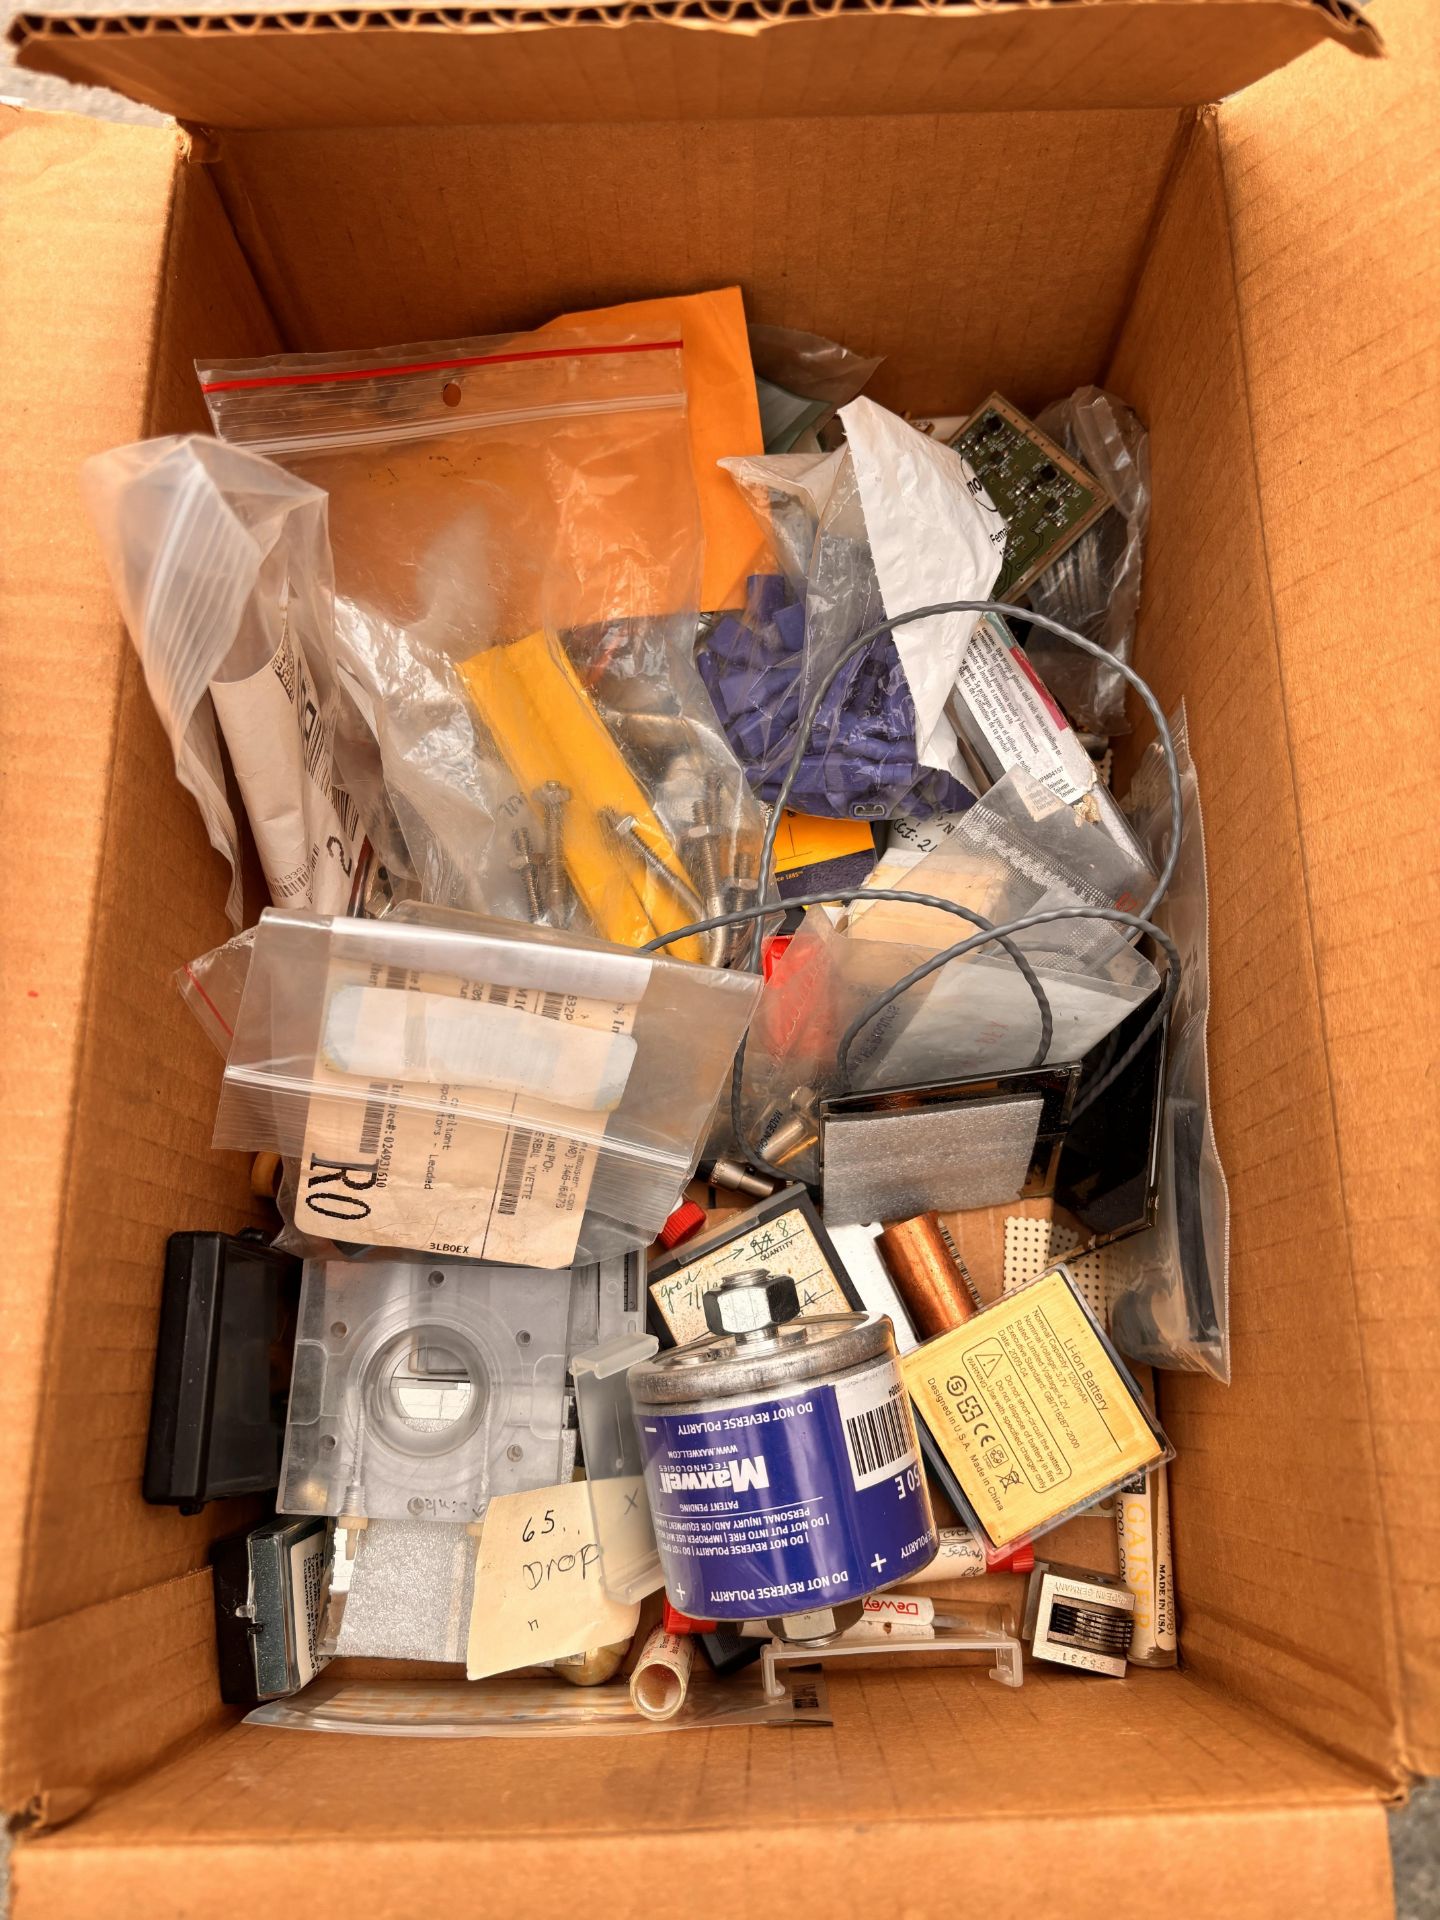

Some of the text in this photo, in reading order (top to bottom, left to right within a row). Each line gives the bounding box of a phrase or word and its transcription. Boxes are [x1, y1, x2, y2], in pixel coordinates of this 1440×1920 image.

[760, 1240, 793, 1261] QUANTITY
[1030, 1308, 1052, 1339] Nominal
[1004, 1323, 1028, 1358] Executive
[1013, 1318, 1030, 1342] Rated
[1025, 1340, 1045, 1367] Limited
[1021, 1313, 1043, 1344] Nominal
[1053, 1369, 1070, 1390] 3.7V
[1007, 1348, 1029, 1378] 2009-04
[965, 1356, 988, 1389] WARNING
[1061, 1337, 1111, 1413] Li-ion Battery
[924, 1377, 953, 1417] Designed
[674, 1401, 813, 1435] DO NOT REVERSE POLARITY
[667, 1444, 738, 1458] WWW.MAXWELL.COM
[1039, 1437, 1051, 1451] the
[658, 1461, 728, 1473] TECHNOLOGIES
[1044, 1449, 1065, 1477] battery
[659, 1455, 769, 1494] Maxwell
[968, 1453, 988, 1480] Made
[985, 1485, 1005, 1511] China
[892, 1475, 907, 1500] E
[679, 1500, 738, 1514] PATENT PENDING
[762, 1507, 810, 1523] PERSONAL
[700, 1519, 731, 1531] AND/OR
[732, 1516, 761, 1528] INJURY
[770, 1525, 788, 1535] PUT
[789, 1520, 808, 1532] NOT
[809, 1516, 824, 1527] DO
[687, 1532, 722, 1546] IMPROPER
[728, 1531, 746, 1542] FIRE
[747, 1528, 768, 1539] INTO
[789, 1534, 803, 1545] DO
[695, 1544, 729, 1558] POLARITY
[729, 1541, 767, 1554] REVERSE
[768, 1538, 787, 1549] NOT
[301, 1559, 310, 1610] Customer
[708, 1570, 848, 1605] DO NOT REVERSE POLARITY
[1157, 1564, 1167, 1634] MADE IN USA
